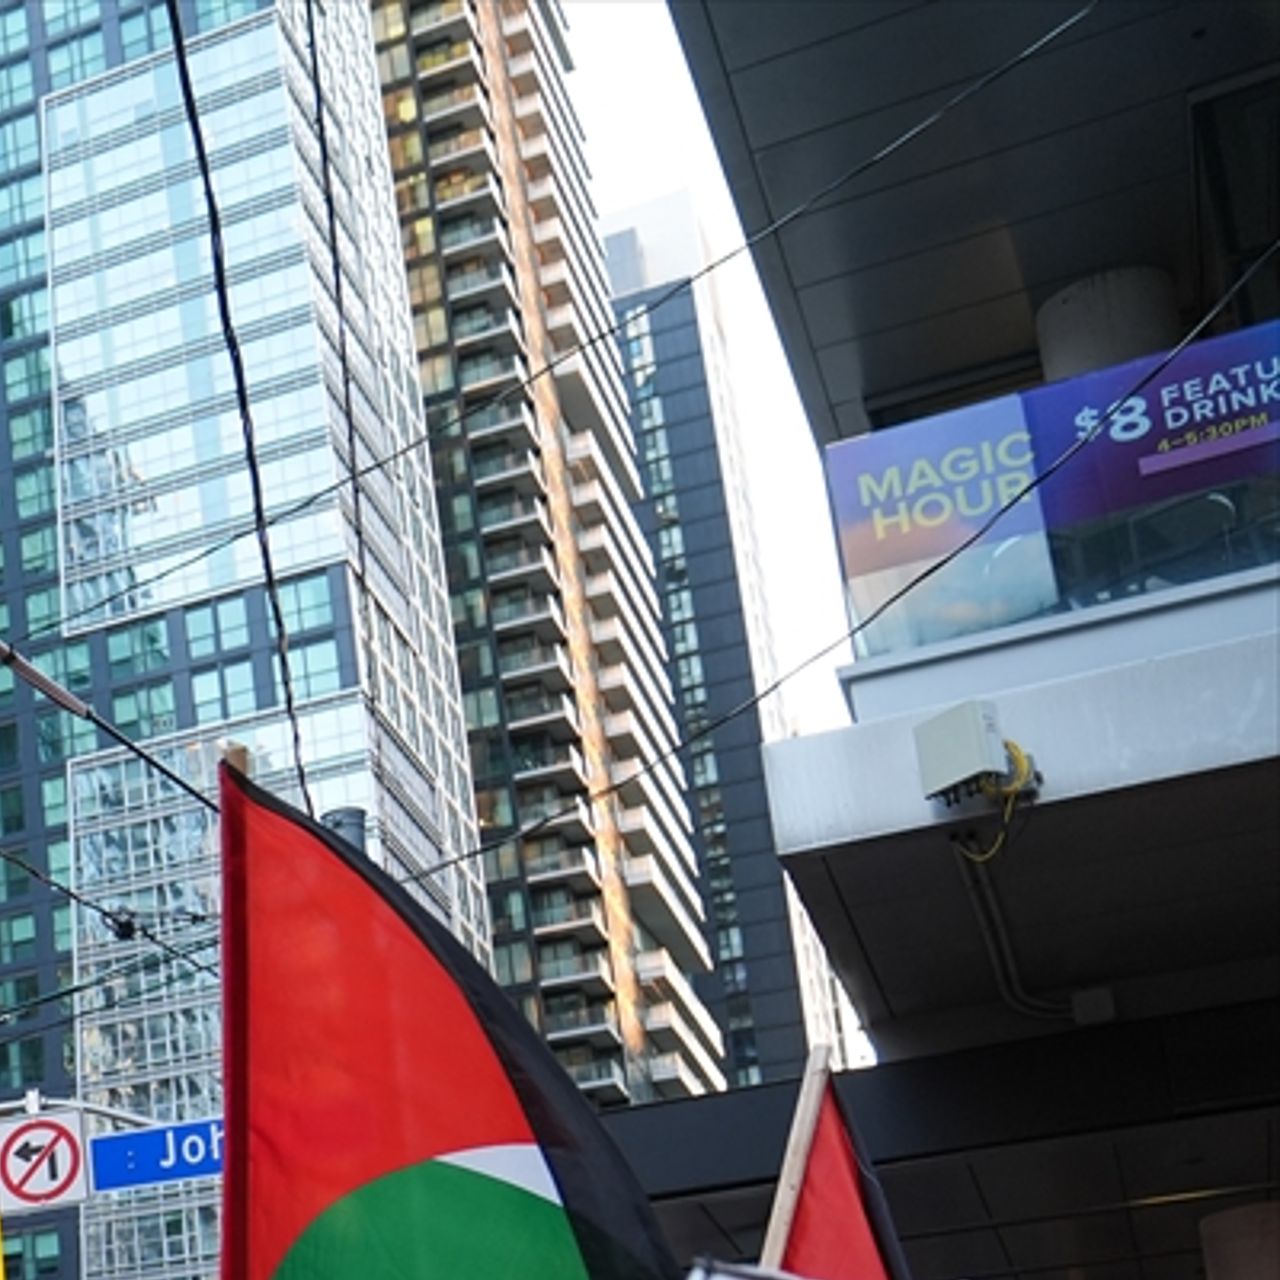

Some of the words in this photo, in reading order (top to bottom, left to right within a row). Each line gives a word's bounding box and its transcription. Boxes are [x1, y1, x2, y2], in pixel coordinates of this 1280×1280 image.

[1160, 357, 1280, 407] FEATU
[1164, 379, 1280, 430] DRINK
[857, 431, 1035, 508] MAGIC
[871, 471, 1032, 540] HOUR
